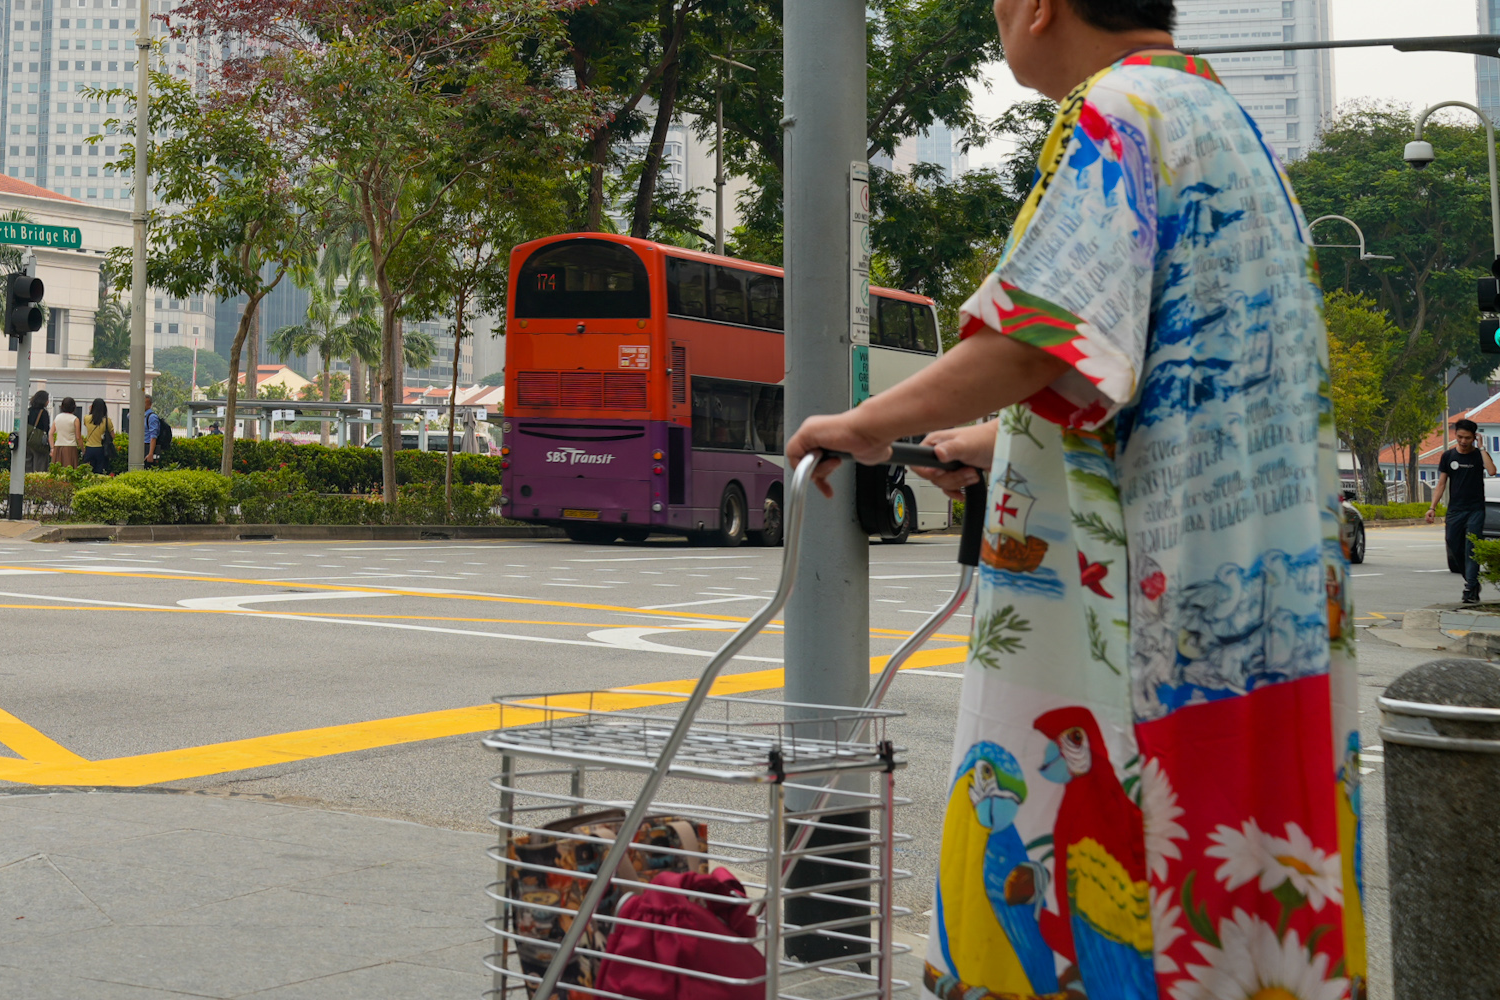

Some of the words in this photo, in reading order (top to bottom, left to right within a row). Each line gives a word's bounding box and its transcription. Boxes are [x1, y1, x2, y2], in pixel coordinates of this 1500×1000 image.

[20, 225, 59, 245] Bridge
[63, 229, 77, 244] Rd
[537, 273, 556, 290] 174
[545, 451, 567, 463] SBS
[558, 447, 616, 465] Transit
